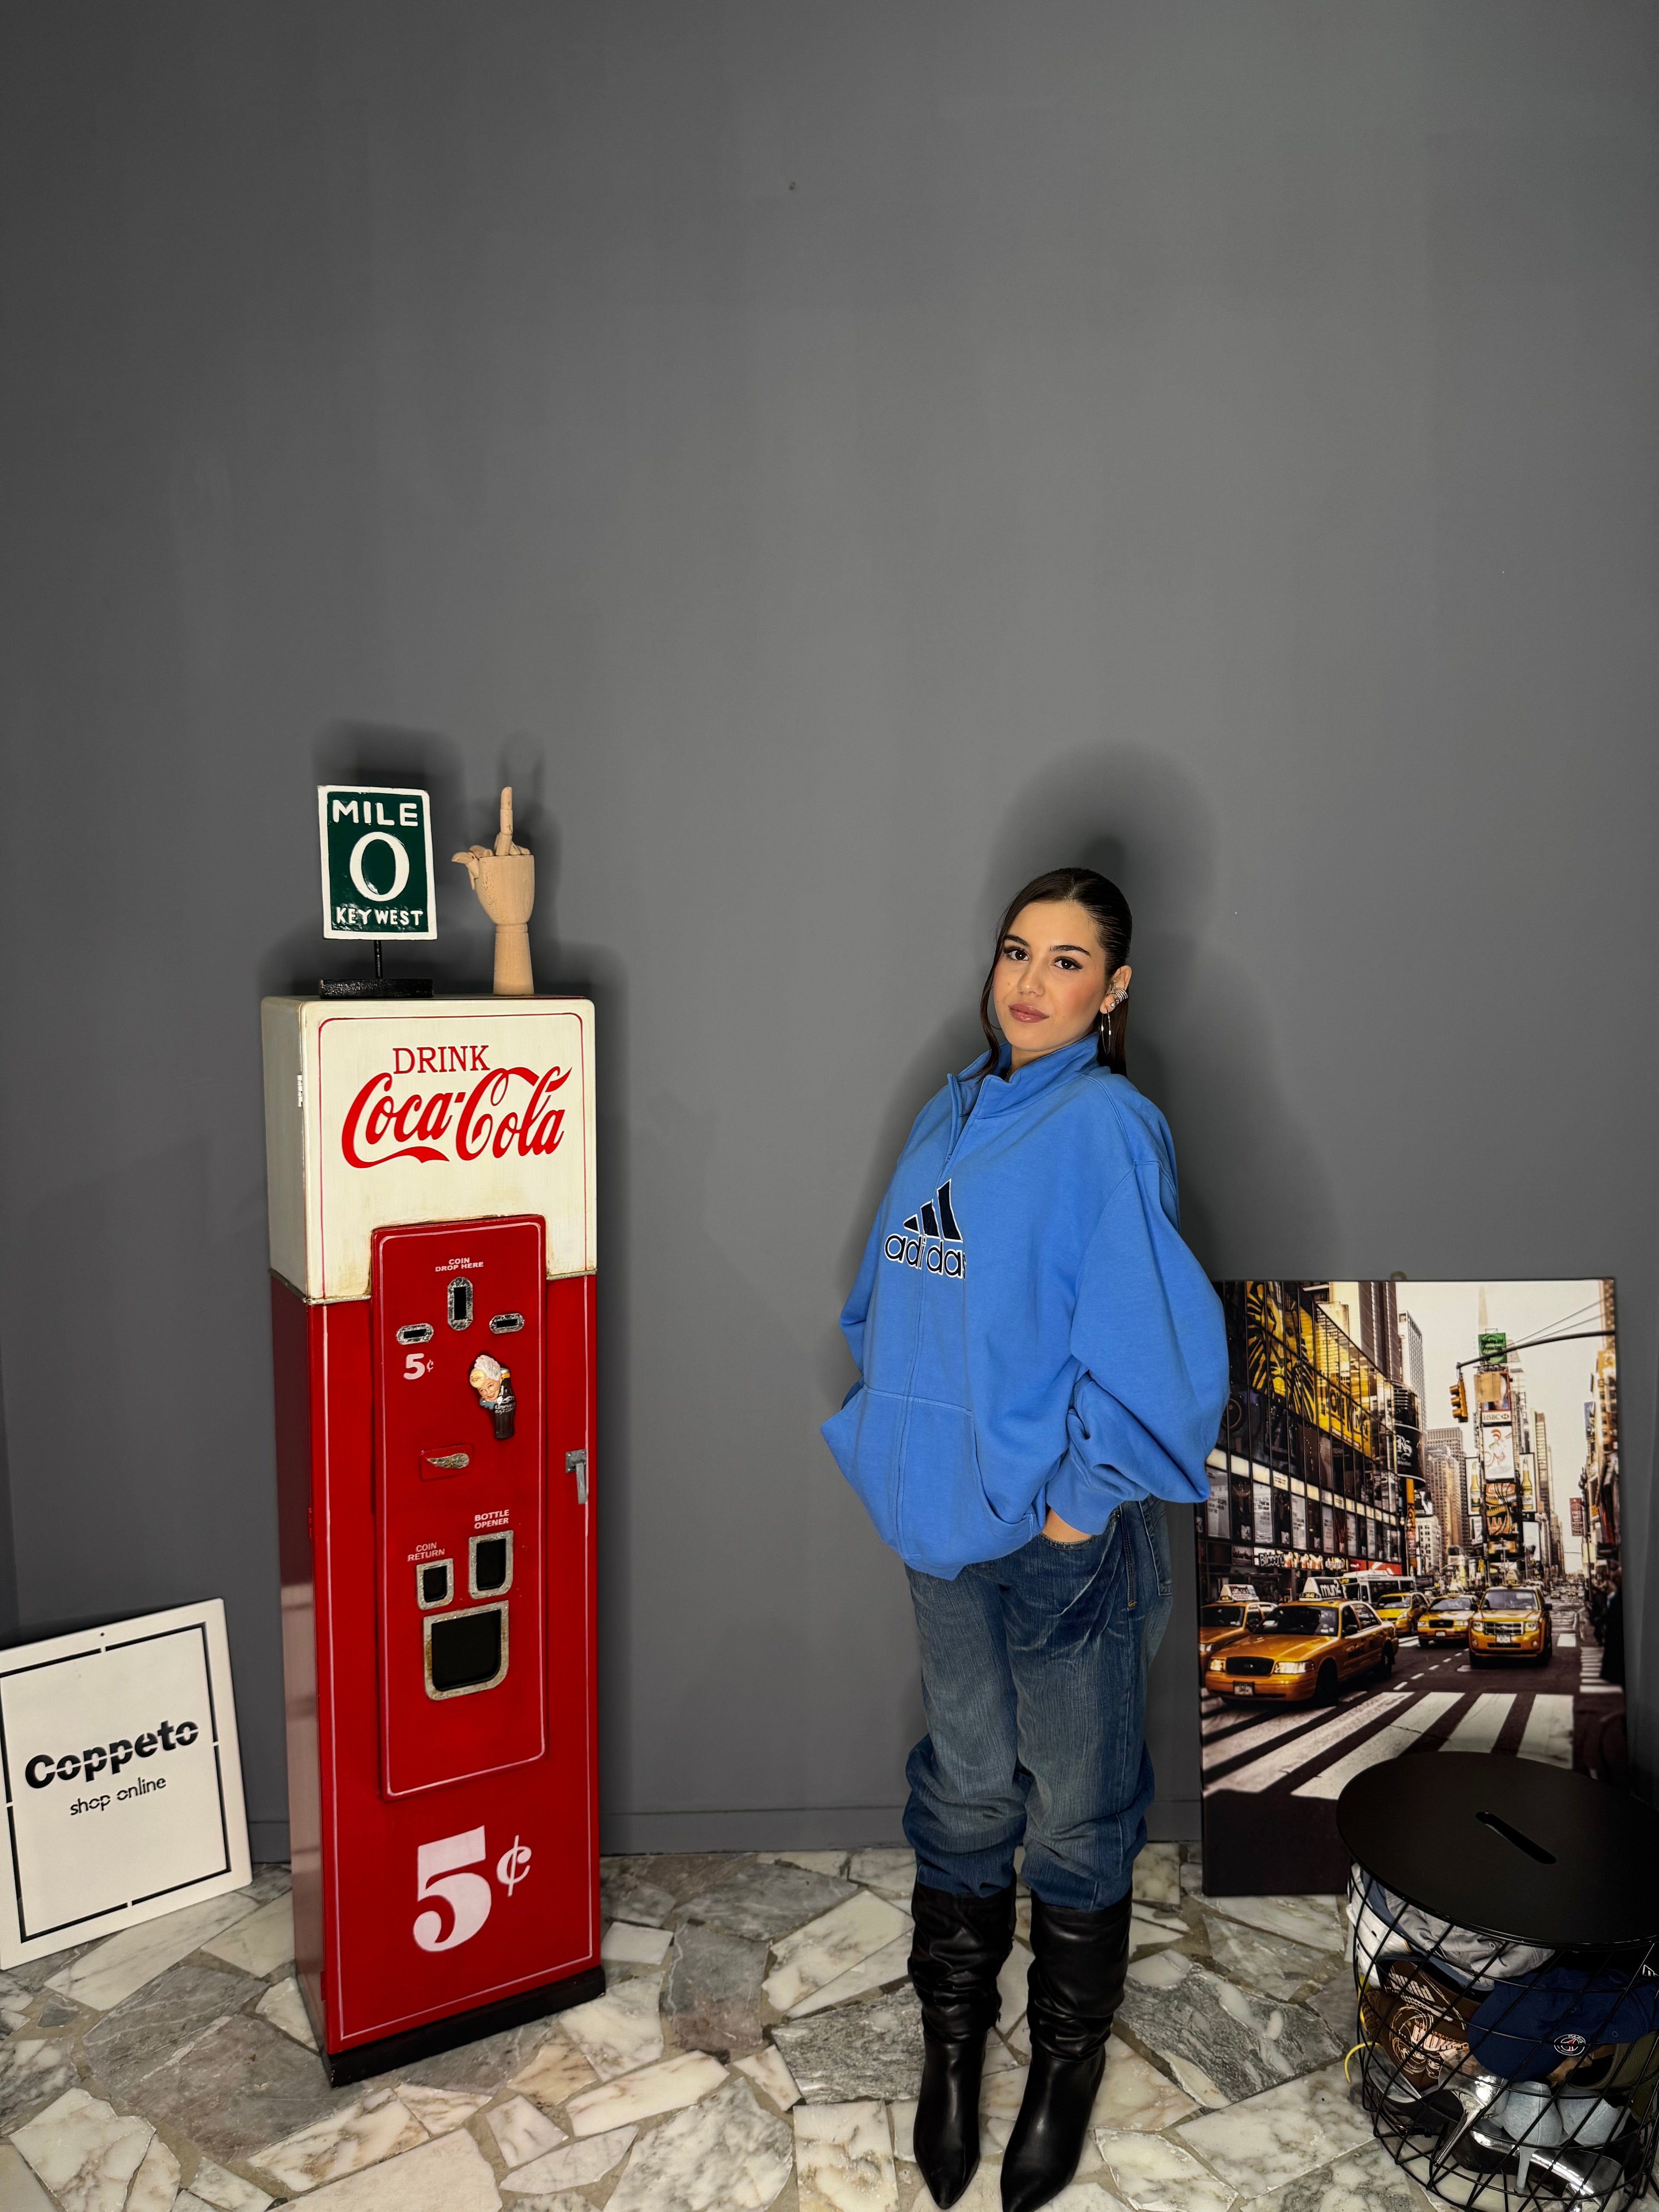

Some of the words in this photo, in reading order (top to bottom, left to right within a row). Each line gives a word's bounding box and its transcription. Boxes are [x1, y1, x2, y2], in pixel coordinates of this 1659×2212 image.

[333, 799, 419, 827] MILE
[335, 907, 372, 925] KEY
[373, 909, 424, 926] WEST
[392, 1045, 490, 1074] DRINK
[341, 1065, 573, 1169] Coca-Cola
[435, 1264, 458, 1272] DROP
[461, 1261, 484, 1270] HERE
[474, 1509, 510, 1522] BOTTLE
[474, 1517, 509, 1530] OPENER
[407, 1548, 445, 1562] RETURN
[415, 1541, 437, 1553] COIN
[25, 1720, 199, 1789] Coppeto
[70, 1794, 111, 1815] shop
[116, 1777, 167, 1802] online
